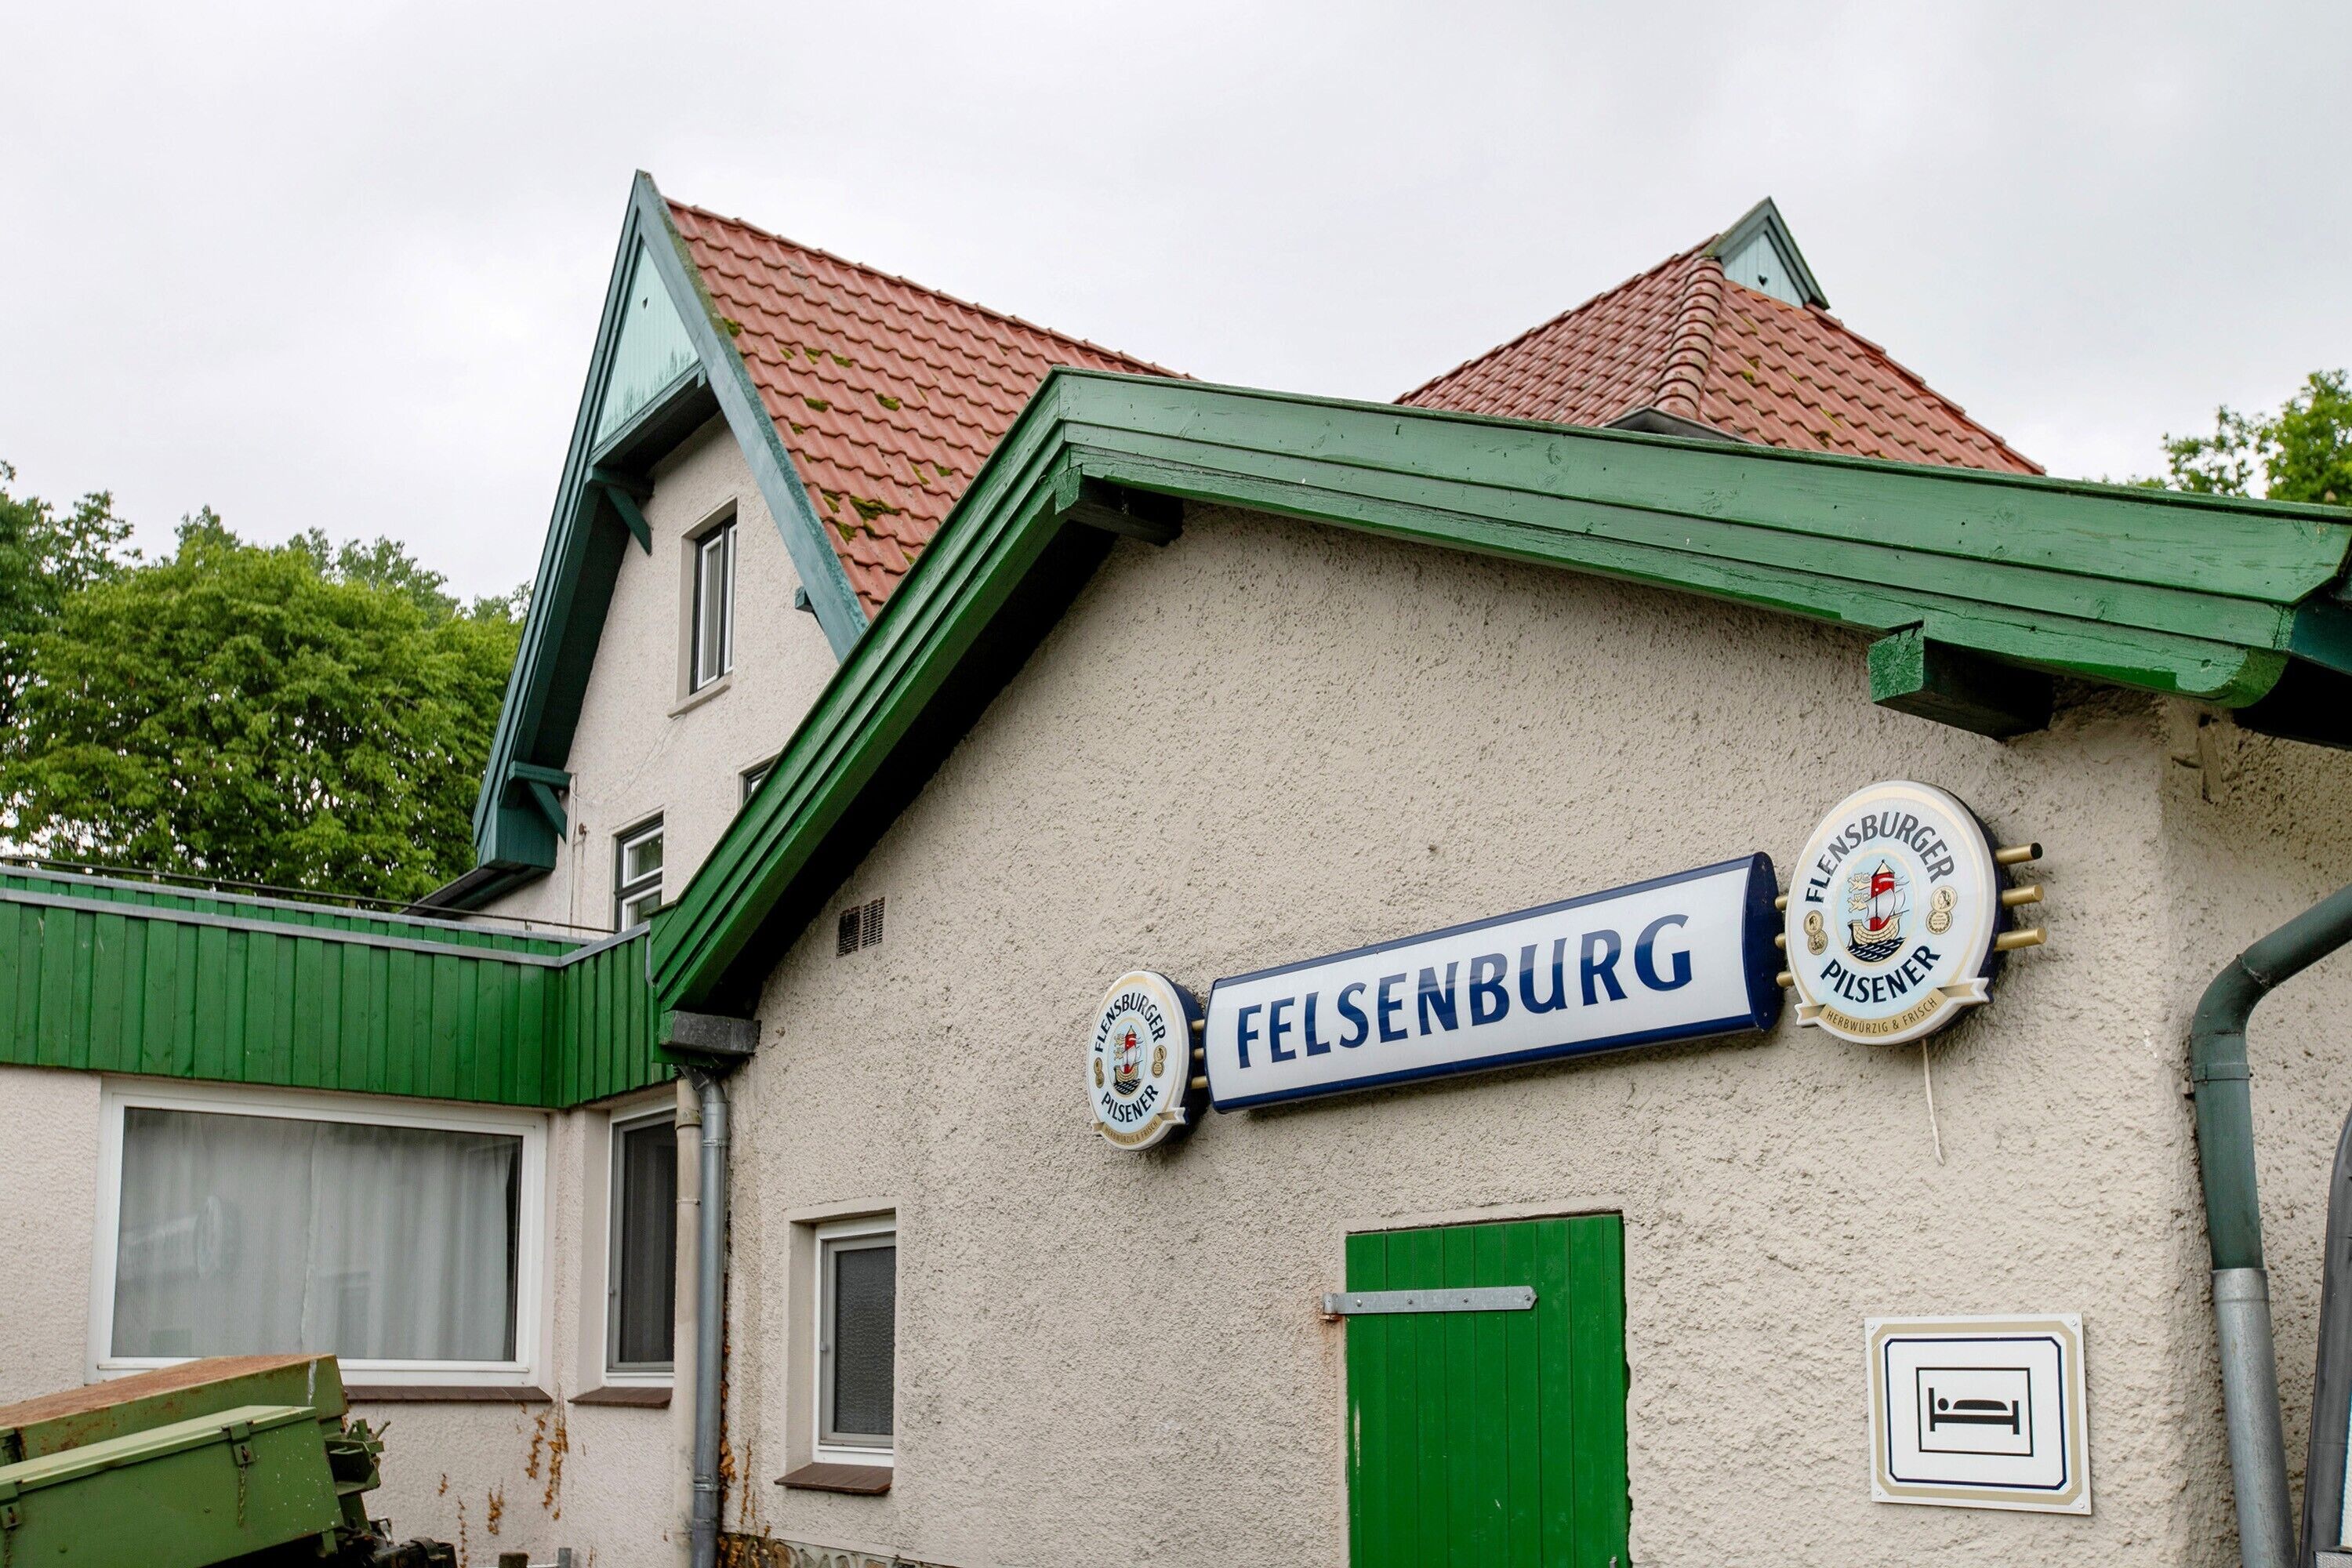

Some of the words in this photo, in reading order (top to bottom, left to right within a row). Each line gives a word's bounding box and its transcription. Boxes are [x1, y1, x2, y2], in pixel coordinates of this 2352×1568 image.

[1805, 811, 1955, 903] FLENSBURGER
[1238, 913, 1693, 1069] FELSENBURG
[1820, 945, 1941, 1003] PILSENER
[1094, 992, 1167, 1053] FLENSBURGER
[1827, 1011, 1888, 1033] HERBWÜRZIG
[1893, 1019, 1899, 1030] &
[1903, 997, 1938, 1025] FRISCH
[1101, 1084, 1160, 1123] PILSENER
